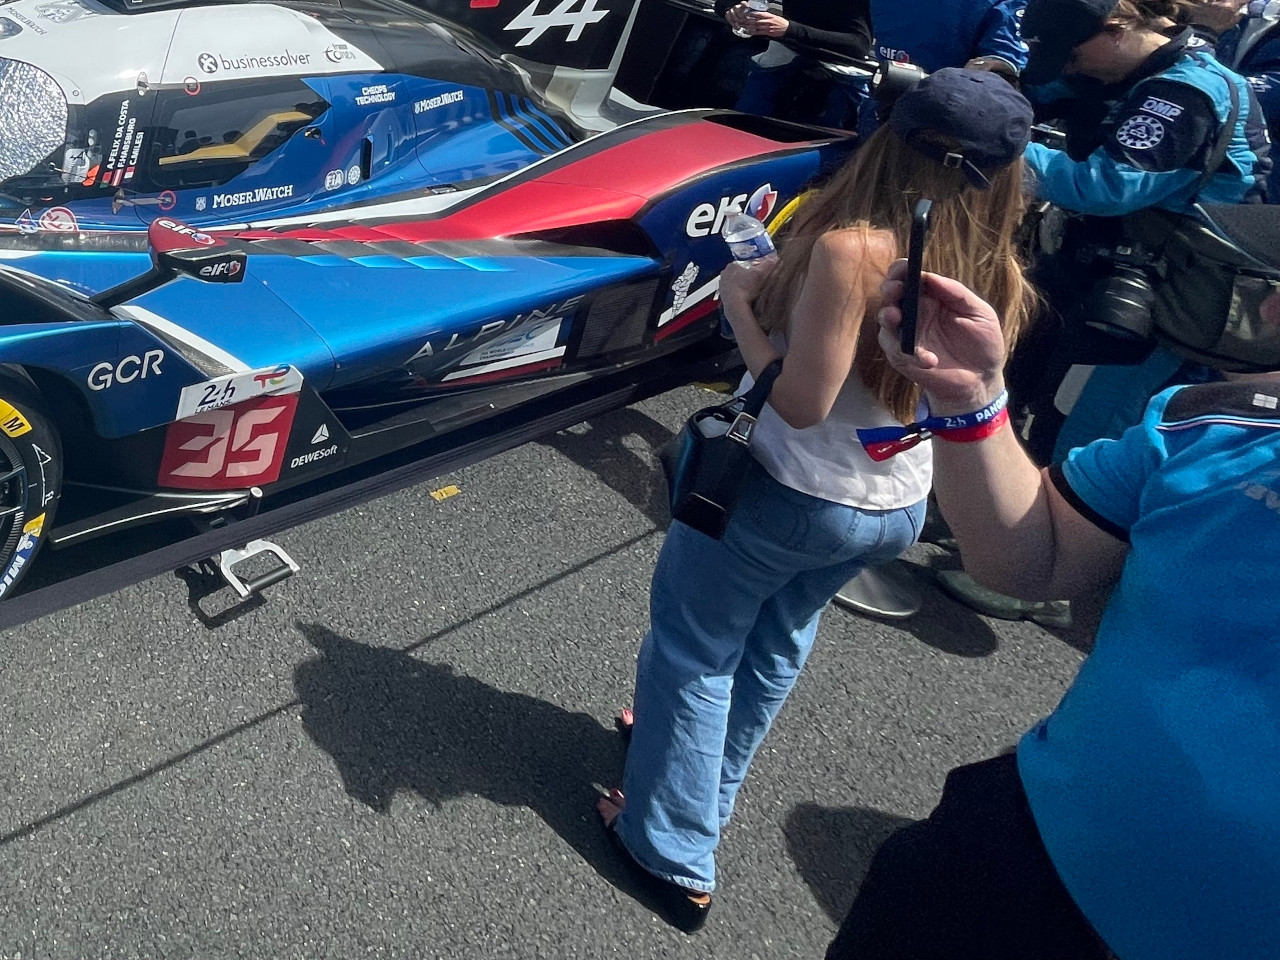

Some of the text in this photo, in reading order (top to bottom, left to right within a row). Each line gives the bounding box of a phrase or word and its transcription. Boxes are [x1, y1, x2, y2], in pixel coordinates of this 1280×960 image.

[219, 49, 311, 71] businessolver
[355, 92, 396, 105] TECHNOLOGY
[362, 85, 388, 95] CHEOPS
[420, 90, 464, 113] MOSER.WATCH
[1142, 99, 1182, 118] OMP
[119, 100, 130, 126] COSTA
[115, 128, 124, 138] DA
[212, 185, 294, 209] MOSER.WATCH
[158, 220, 195, 236] elf
[199, 262, 228, 277] elf
[402, 295, 586, 366] ALPINE
[87, 349, 164, 390] GCR
[3, 415, 24, 433] M
[170, 405, 287, 478] 35
[290, 444, 338, 468] DEWESoft
